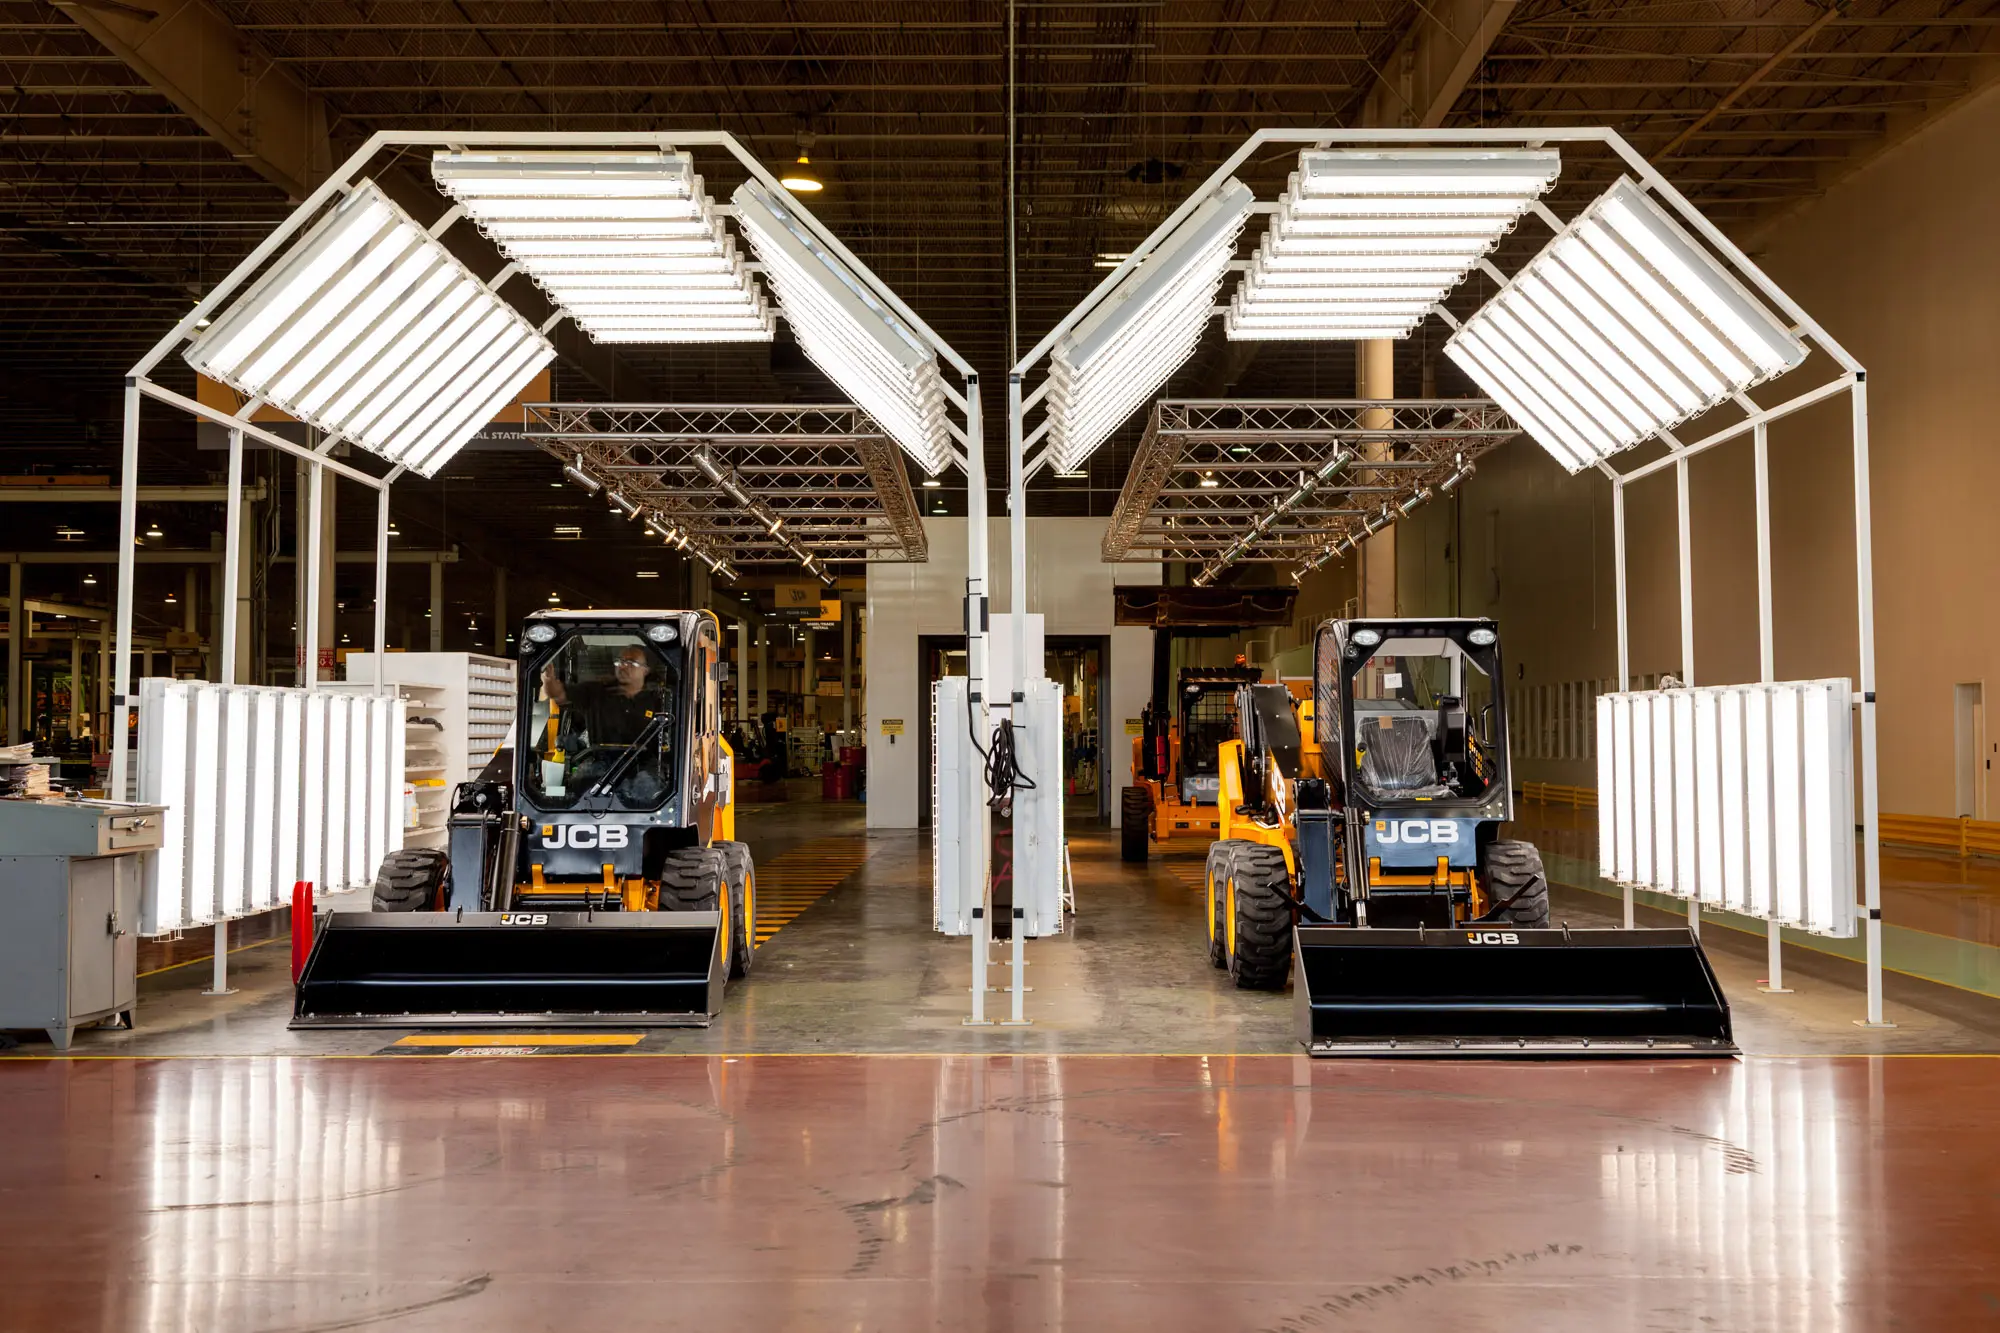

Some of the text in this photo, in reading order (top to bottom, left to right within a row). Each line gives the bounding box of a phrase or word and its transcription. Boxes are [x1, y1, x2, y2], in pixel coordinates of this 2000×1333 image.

[541, 824, 629, 849] JCB
[1375, 820, 1459, 844] JCB
[501, 913, 549, 925] JCB
[1467, 932, 1520, 945] JCB
